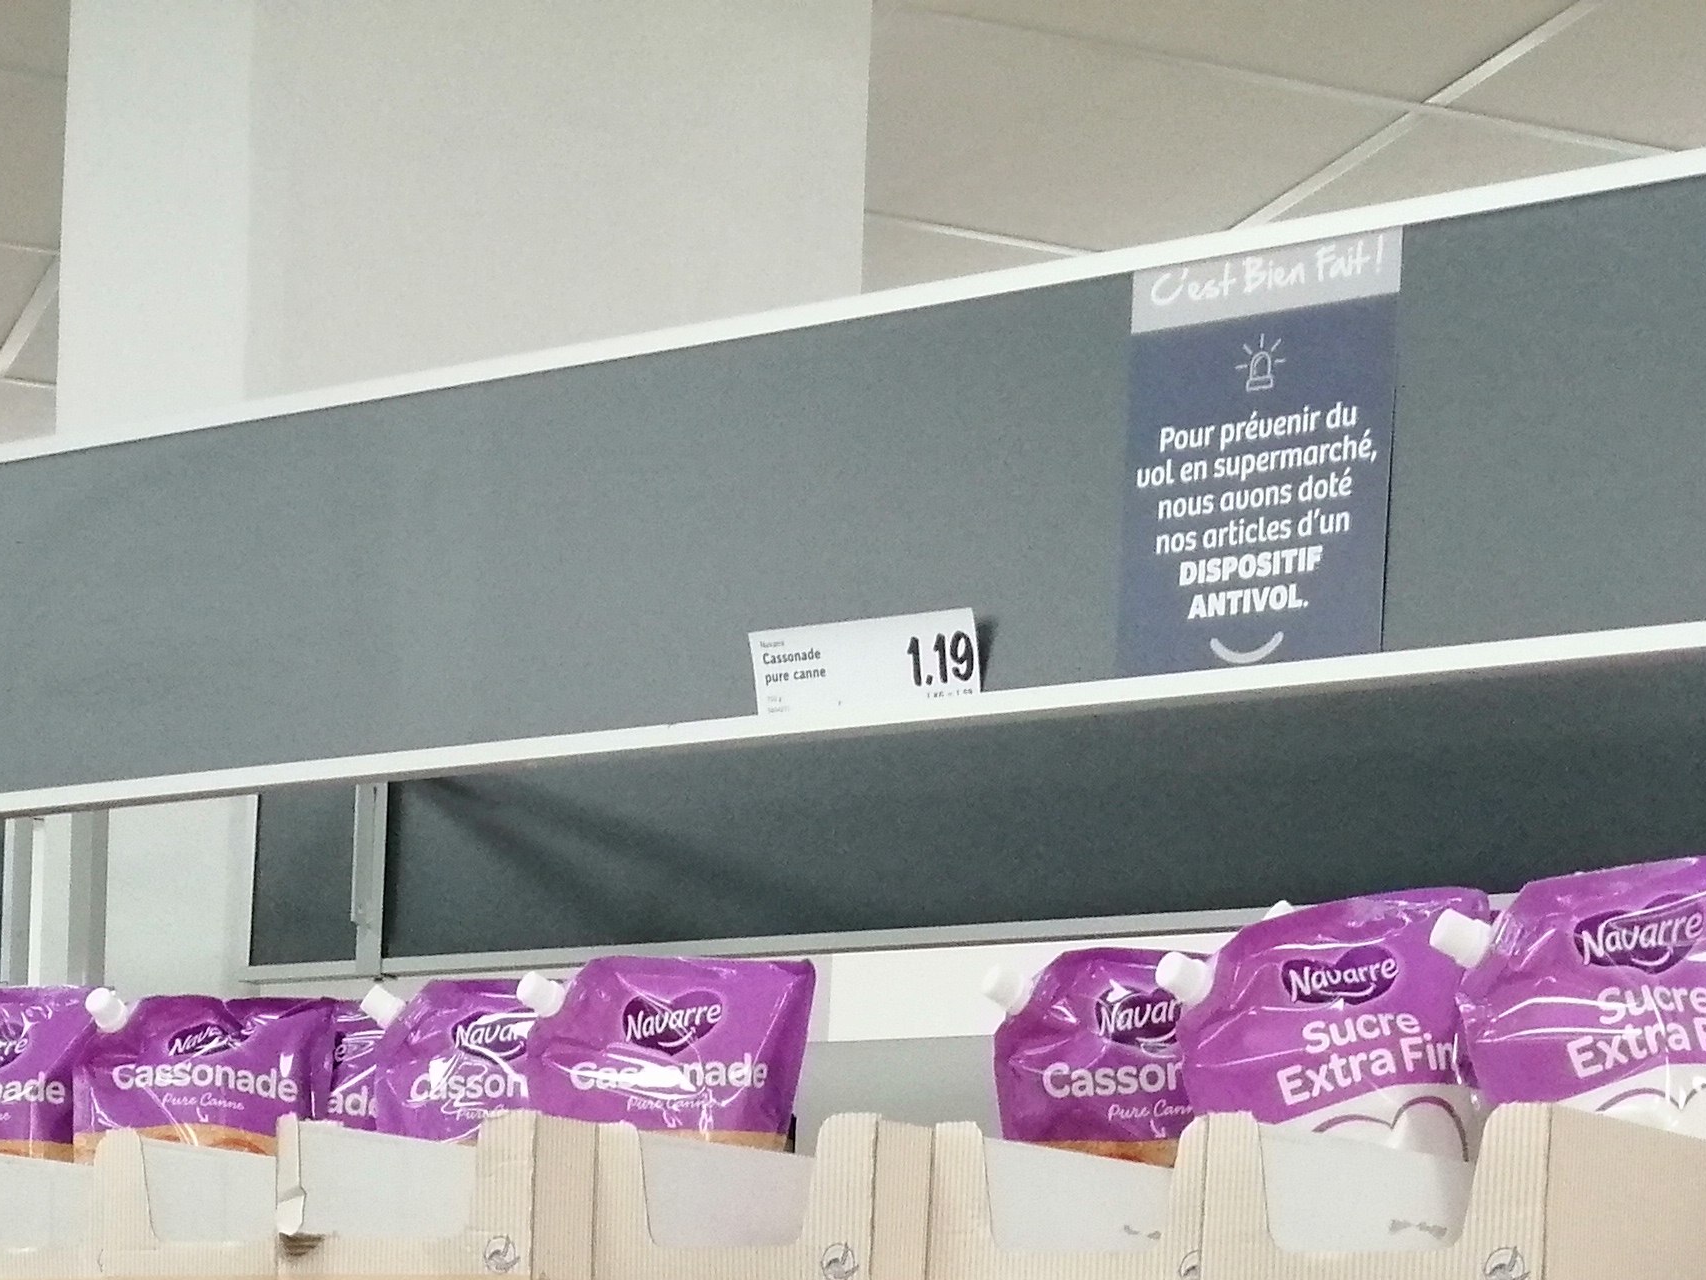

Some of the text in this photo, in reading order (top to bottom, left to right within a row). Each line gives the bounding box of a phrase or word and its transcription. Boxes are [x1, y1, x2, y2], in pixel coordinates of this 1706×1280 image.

[1151, 255, 1306, 306] C'est Bien
[1160, 402, 1358, 452] Pour prévenir du
[1137, 430, 1378, 487] vol en supermarché,
[1158, 471, 1352, 519] nous avons doté
[1156, 511, 1351, 554] nos articles d'un
[1179, 546, 1322, 586] DISPOSITIF
[1189, 587, 1309, 619] ANTIVOL.
[763, 648, 821, 665] Cassonade
[765, 667, 826, 685] pure canne
[907, 631, 973, 686] 1.19
[1581, 910, 1704, 965] Navarre
[1288, 956, 1398, 1002] Navarre
[625, 1003, 722, 1042] Navarre
[1301, 1010, 1420, 1054] Sucre
[1276, 1033, 1458, 1107] Extra Fin
[1566, 1021, 1689, 1079] Extra
[112, 1062, 298, 1102] Cassonade
